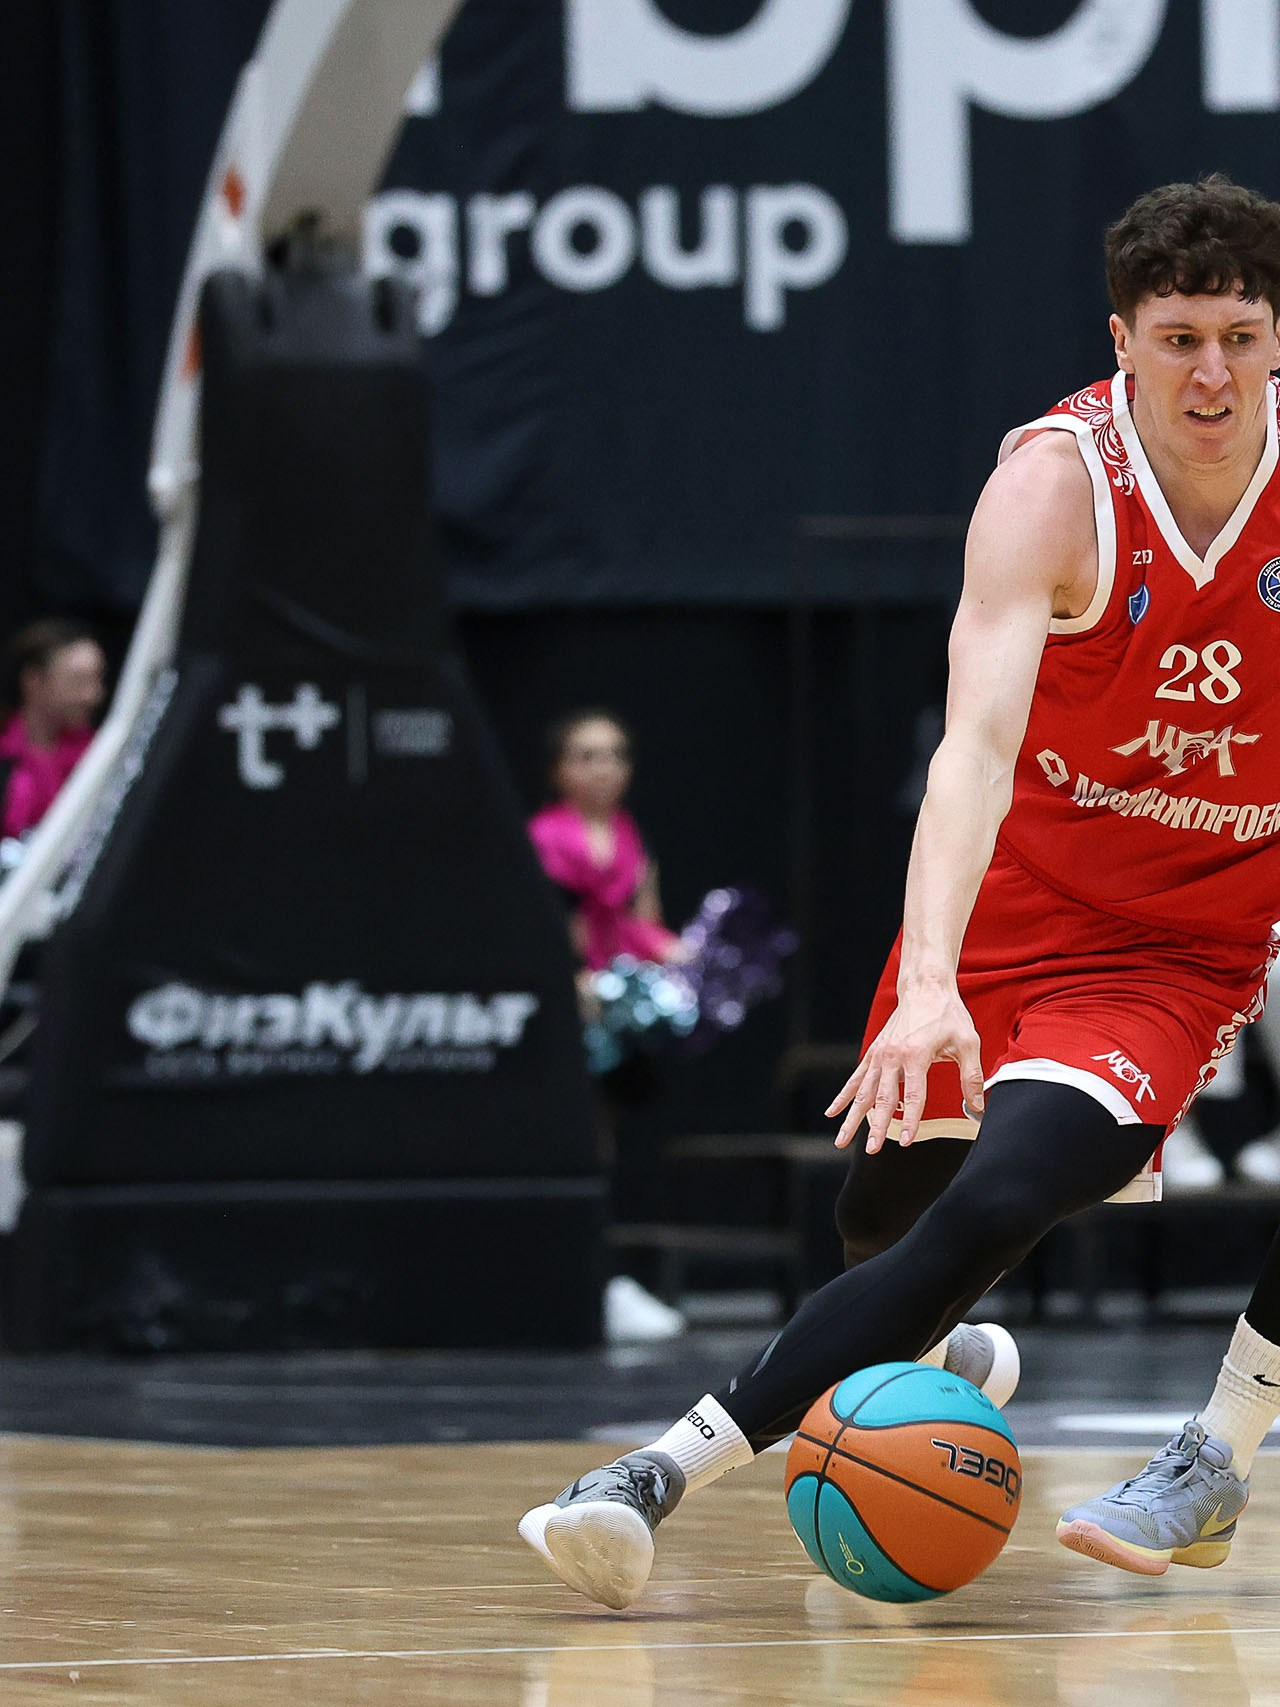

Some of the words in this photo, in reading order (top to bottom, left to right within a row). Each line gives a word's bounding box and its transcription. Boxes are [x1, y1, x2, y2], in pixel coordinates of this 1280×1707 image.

[364, 181, 849, 333] group
[1132, 549, 1153, 565] ZD
[1155, 640, 1243, 704] 28
[931, 1437, 1020, 1505] ÖGEL
